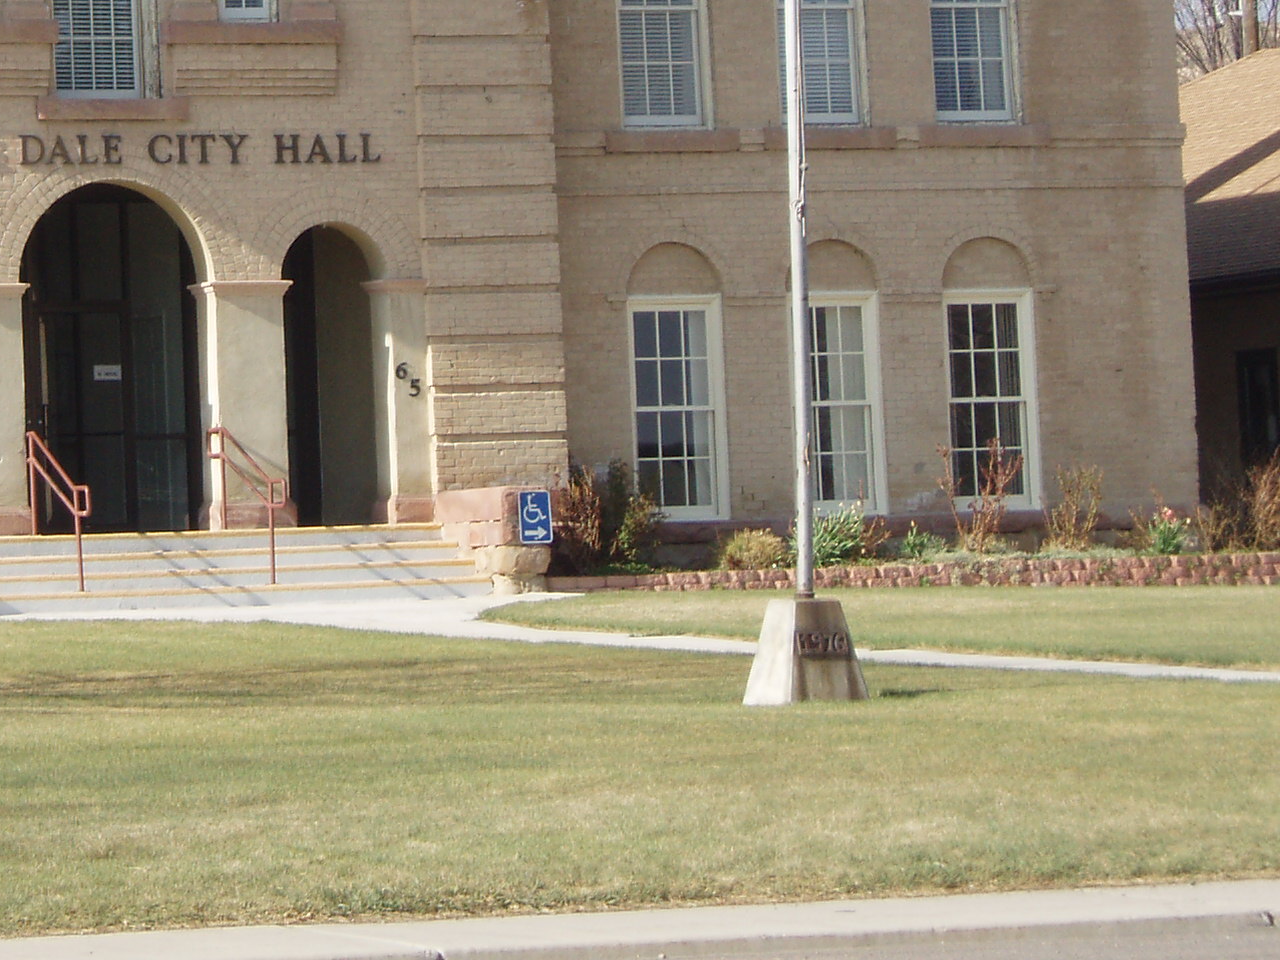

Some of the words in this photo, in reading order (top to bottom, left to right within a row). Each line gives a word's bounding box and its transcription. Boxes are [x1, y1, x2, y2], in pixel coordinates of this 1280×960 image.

[18, 133, 123, 166] DALE
[147, 133, 249, 165] CITY
[273, 132, 382, 165] HALL
[395, 361, 421, 397] 65
